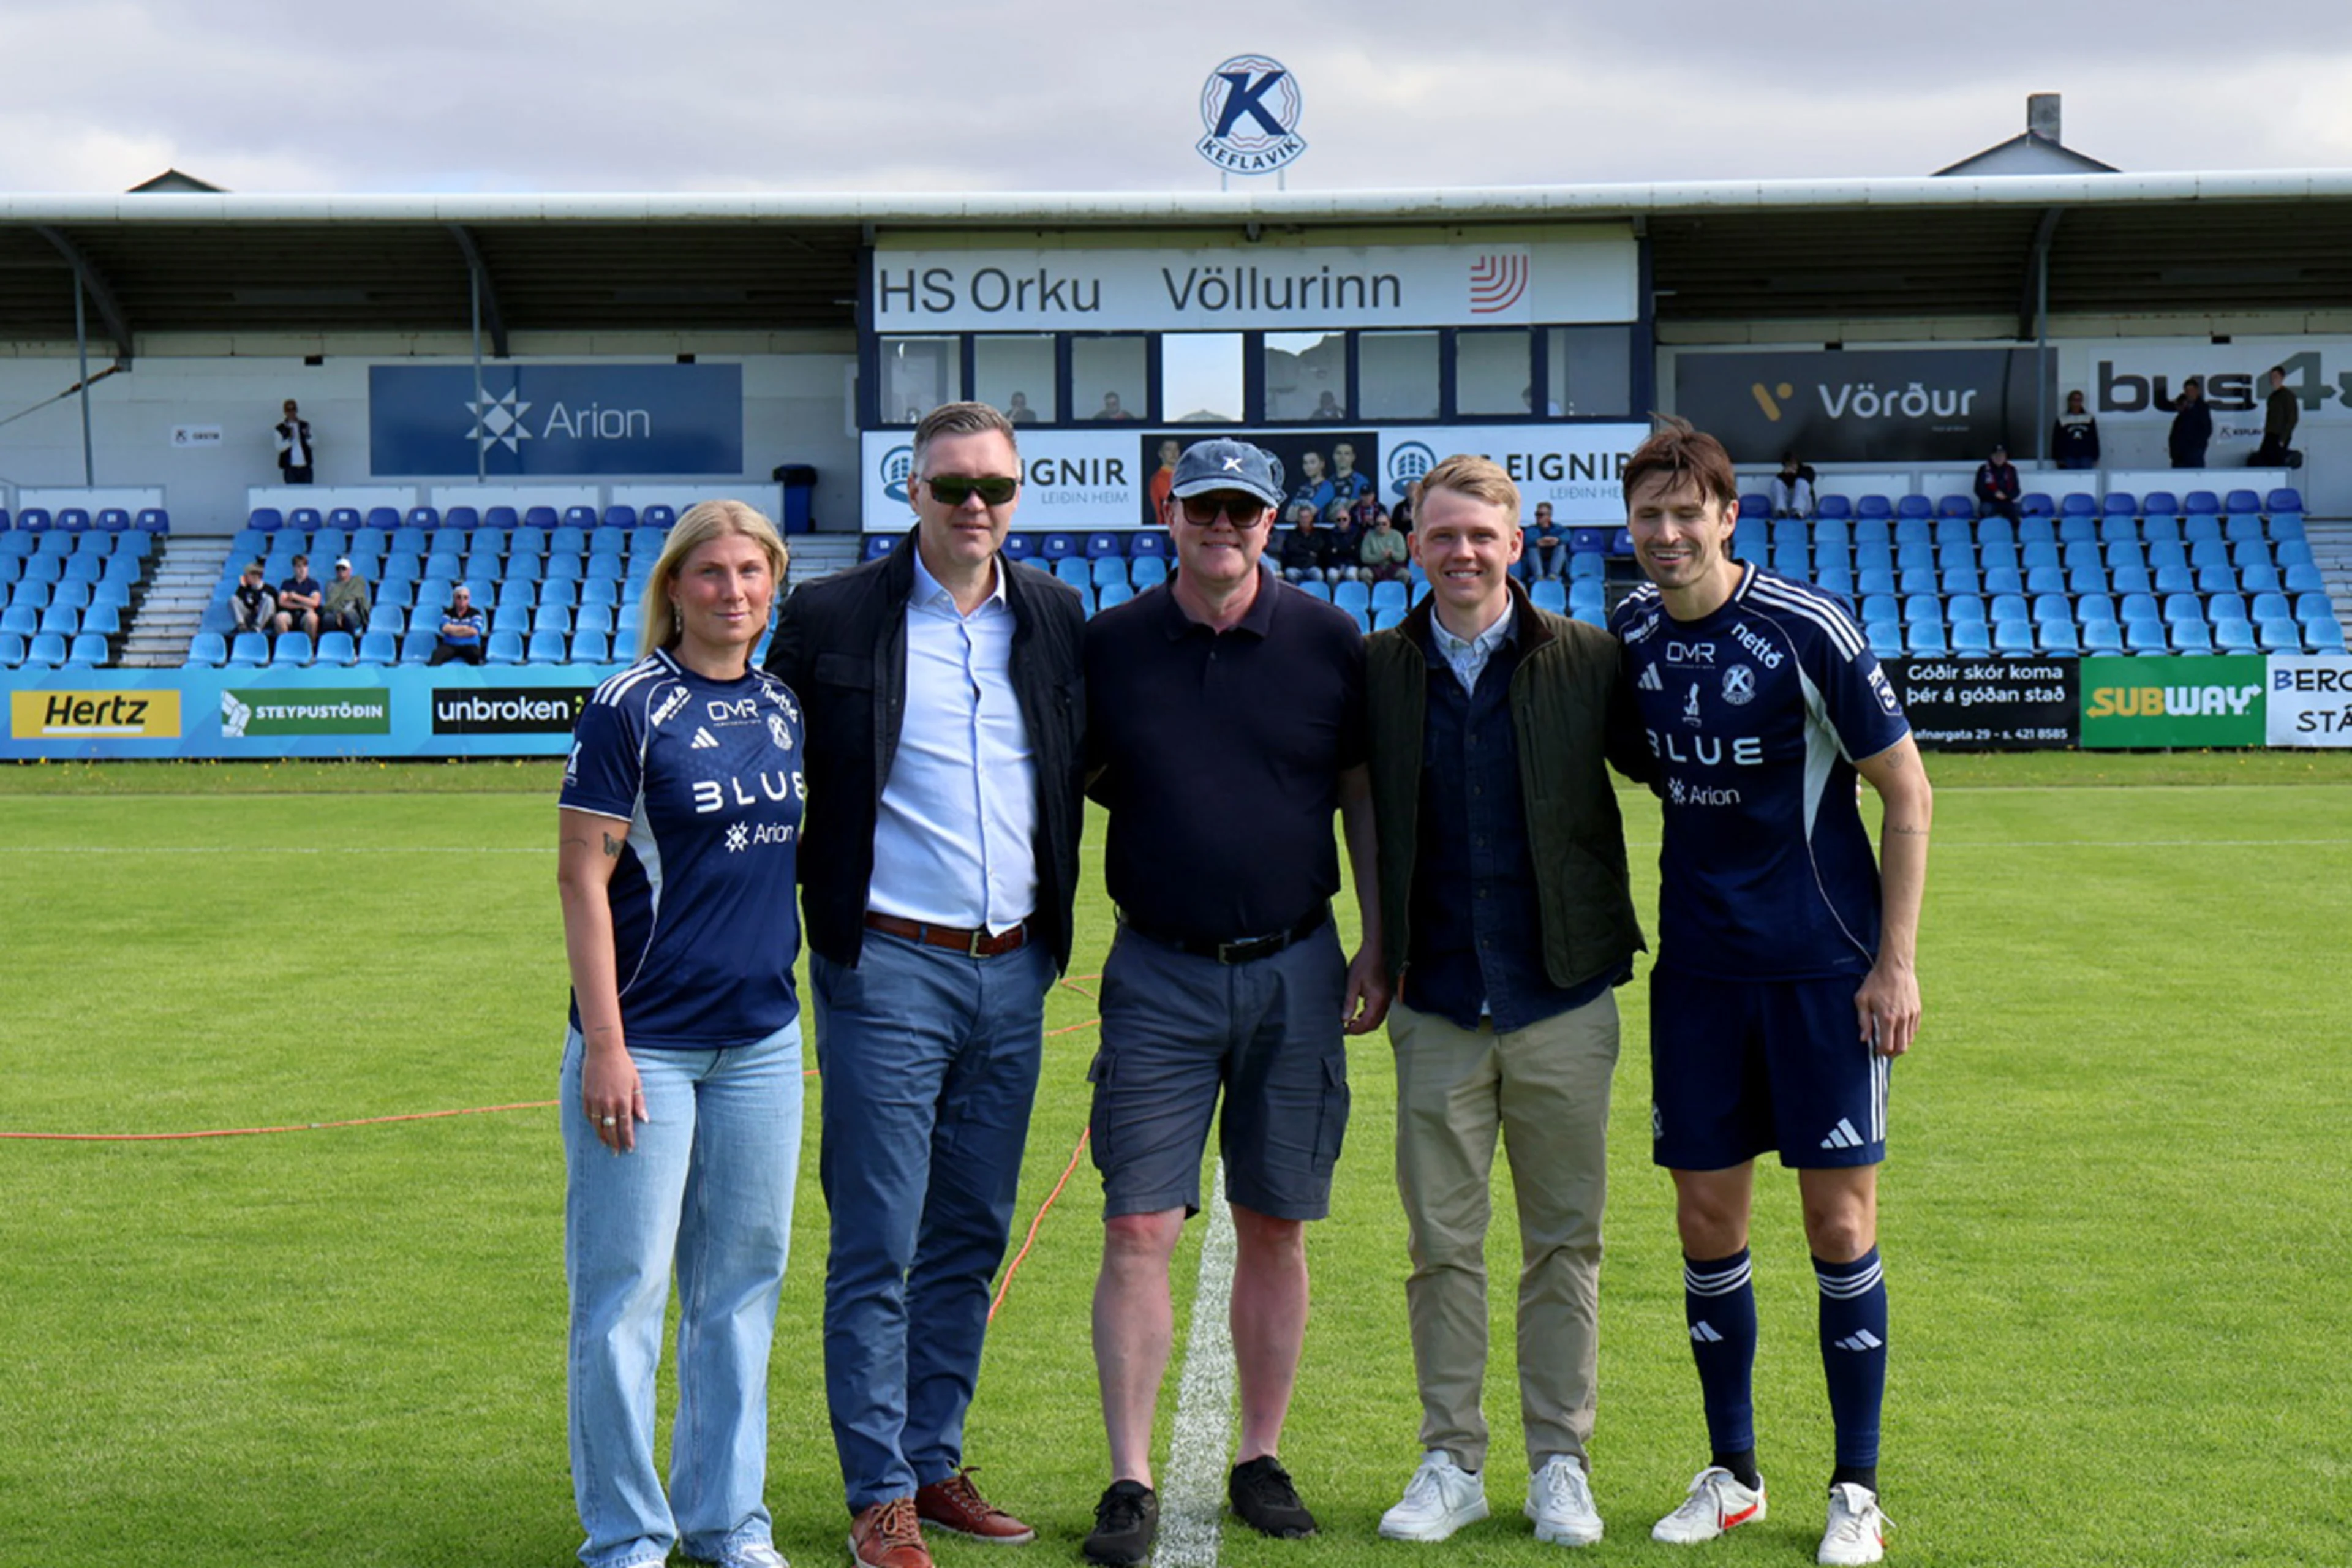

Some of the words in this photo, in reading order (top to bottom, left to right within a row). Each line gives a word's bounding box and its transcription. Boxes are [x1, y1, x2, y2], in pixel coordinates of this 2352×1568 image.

[1202, 138, 1299, 169] KEFLAVIK
[880, 268, 956, 313] HS
[971, 267, 1100, 312] Orku
[1162, 266, 1401, 311] Völlurinn
[1817, 382, 1977, 418] Vörður
[543, 401, 650, 439] Arion
[1092, 491, 1129, 503] HEIM
[1907, 664, 1959, 680] Góðir
[1964, 665, 2005, 679] skór
[2010, 665, 2064, 679] koma
[438, 696, 569, 721] unbroken
[1943, 687, 1954, 703] á
[1959, 688, 2019, 706] góðan
[2024, 685, 2065, 702] stað
[2086, 684, 2263, 718] SUBWAY
[45, 696, 149, 725] Hertz
[1689, 785, 1741, 806] Arion
